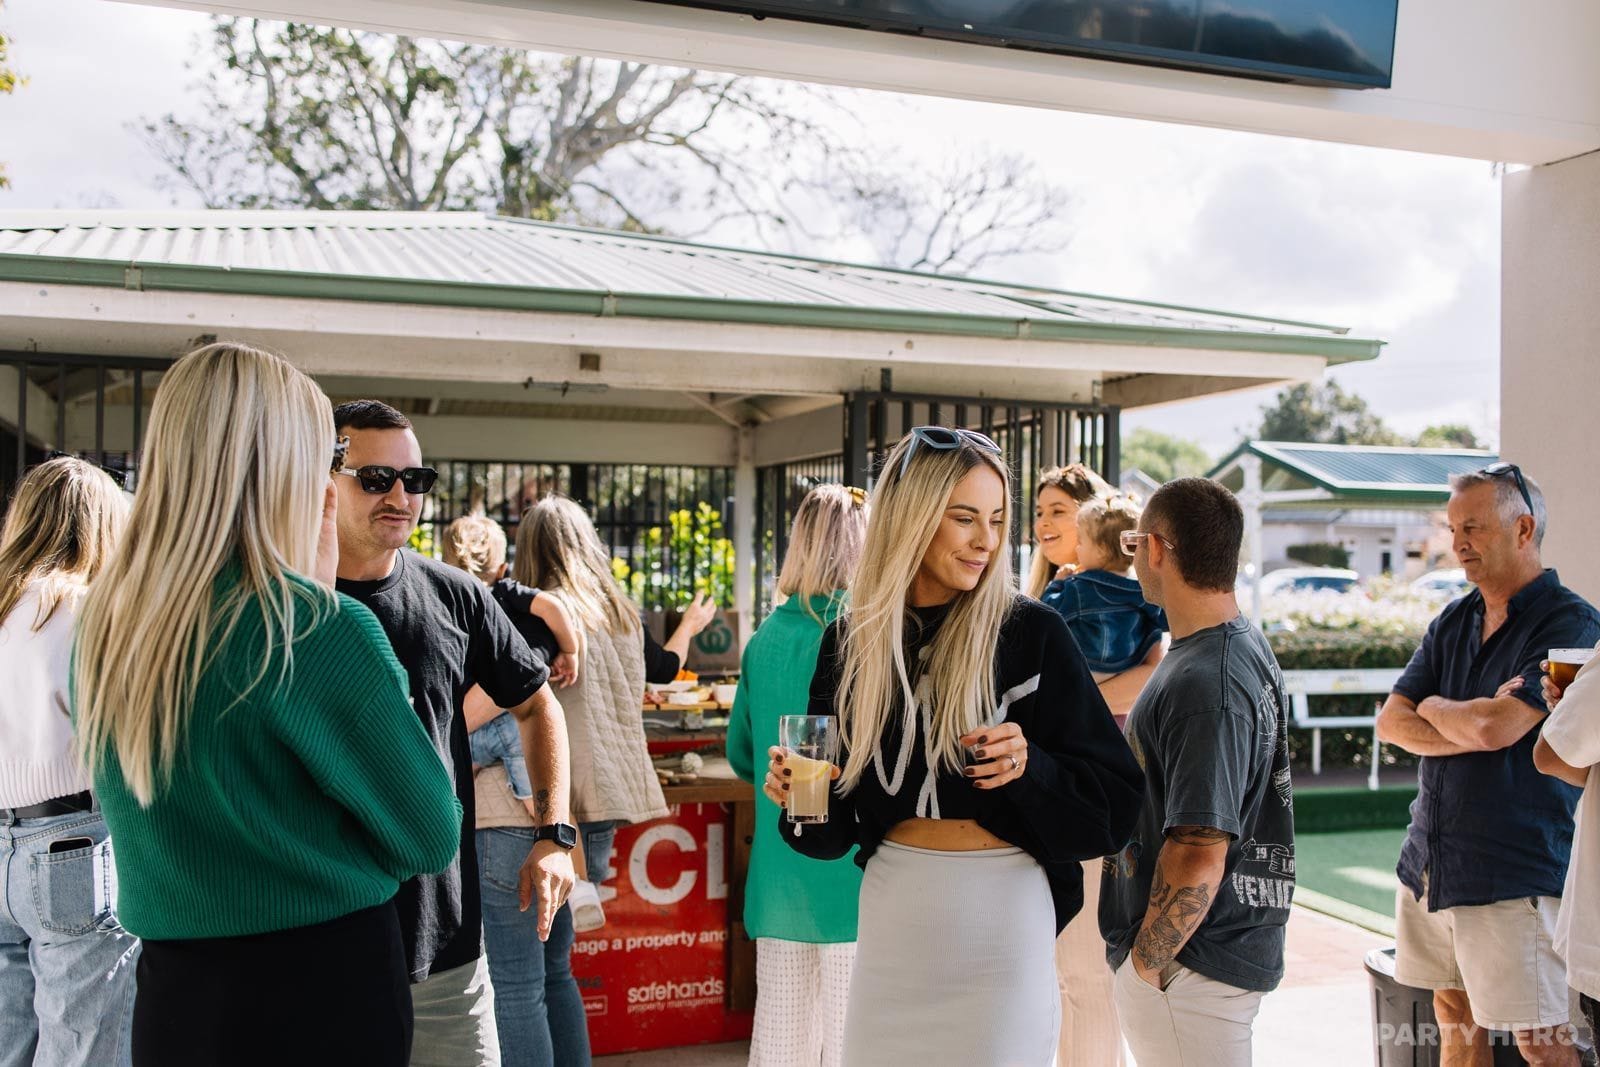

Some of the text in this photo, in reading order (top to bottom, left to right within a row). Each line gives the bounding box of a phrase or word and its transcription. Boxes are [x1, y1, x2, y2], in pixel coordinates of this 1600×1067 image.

[612, 938, 623, 950] a
[626, 930, 697, 952] property
[627, 977, 724, 1003] safehands
